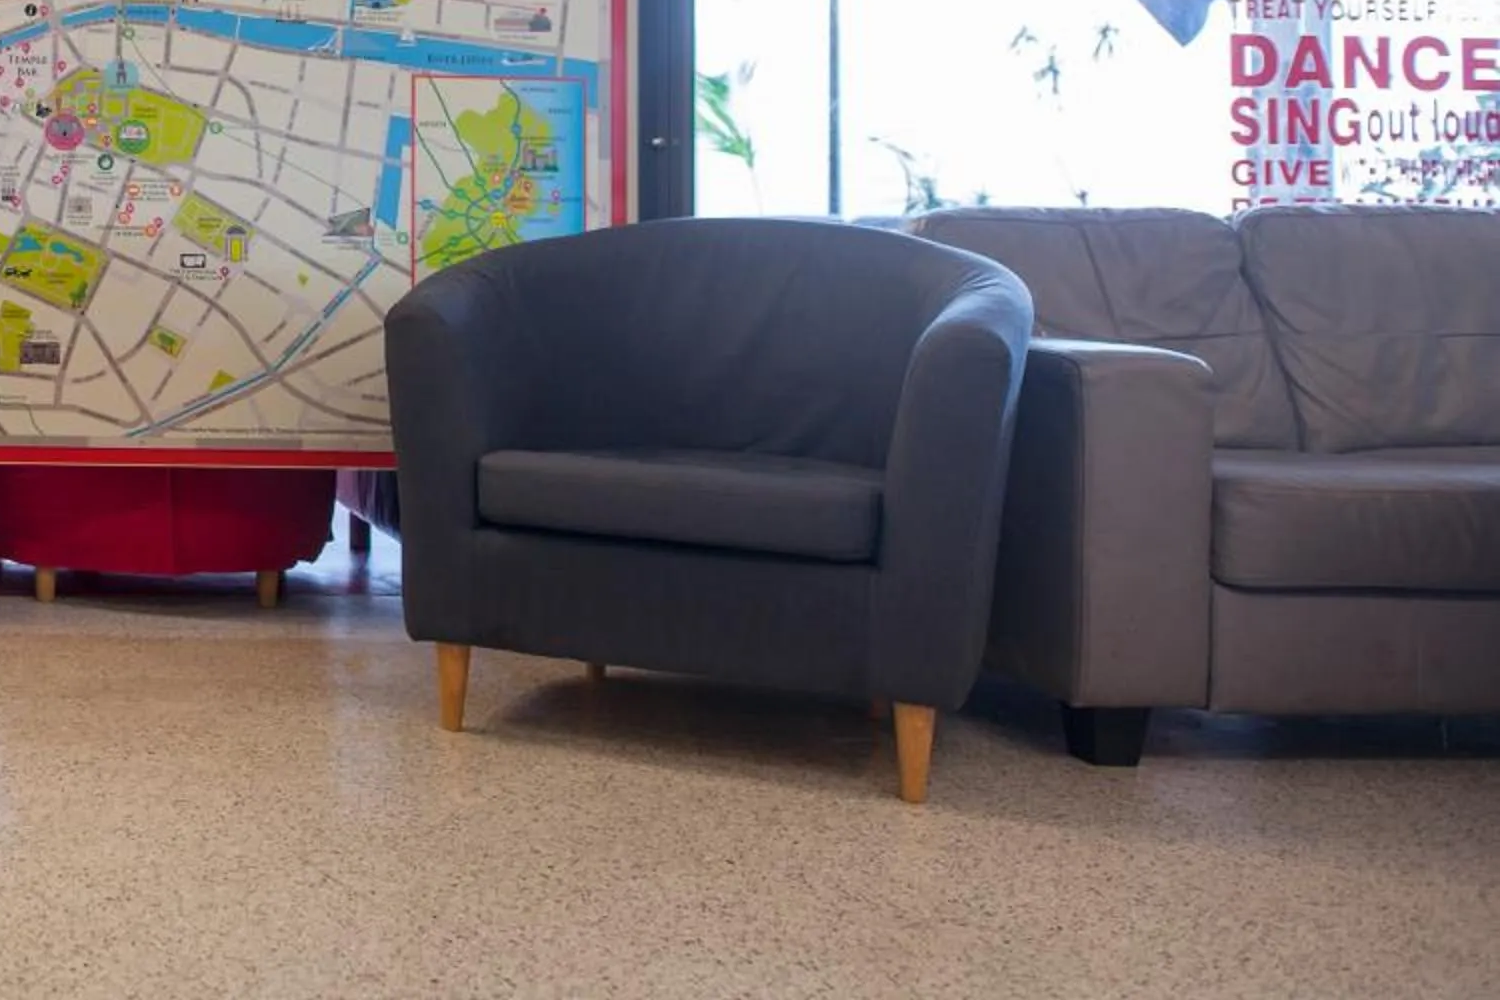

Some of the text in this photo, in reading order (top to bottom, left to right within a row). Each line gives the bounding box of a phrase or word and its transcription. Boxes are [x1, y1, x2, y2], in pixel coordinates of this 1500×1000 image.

[1230, 34, 1500, 92] DANCE
[1230, 96, 1362, 147] SING
[1367, 101, 1421, 144] out
[1231, 159, 1331, 187] GIVE
